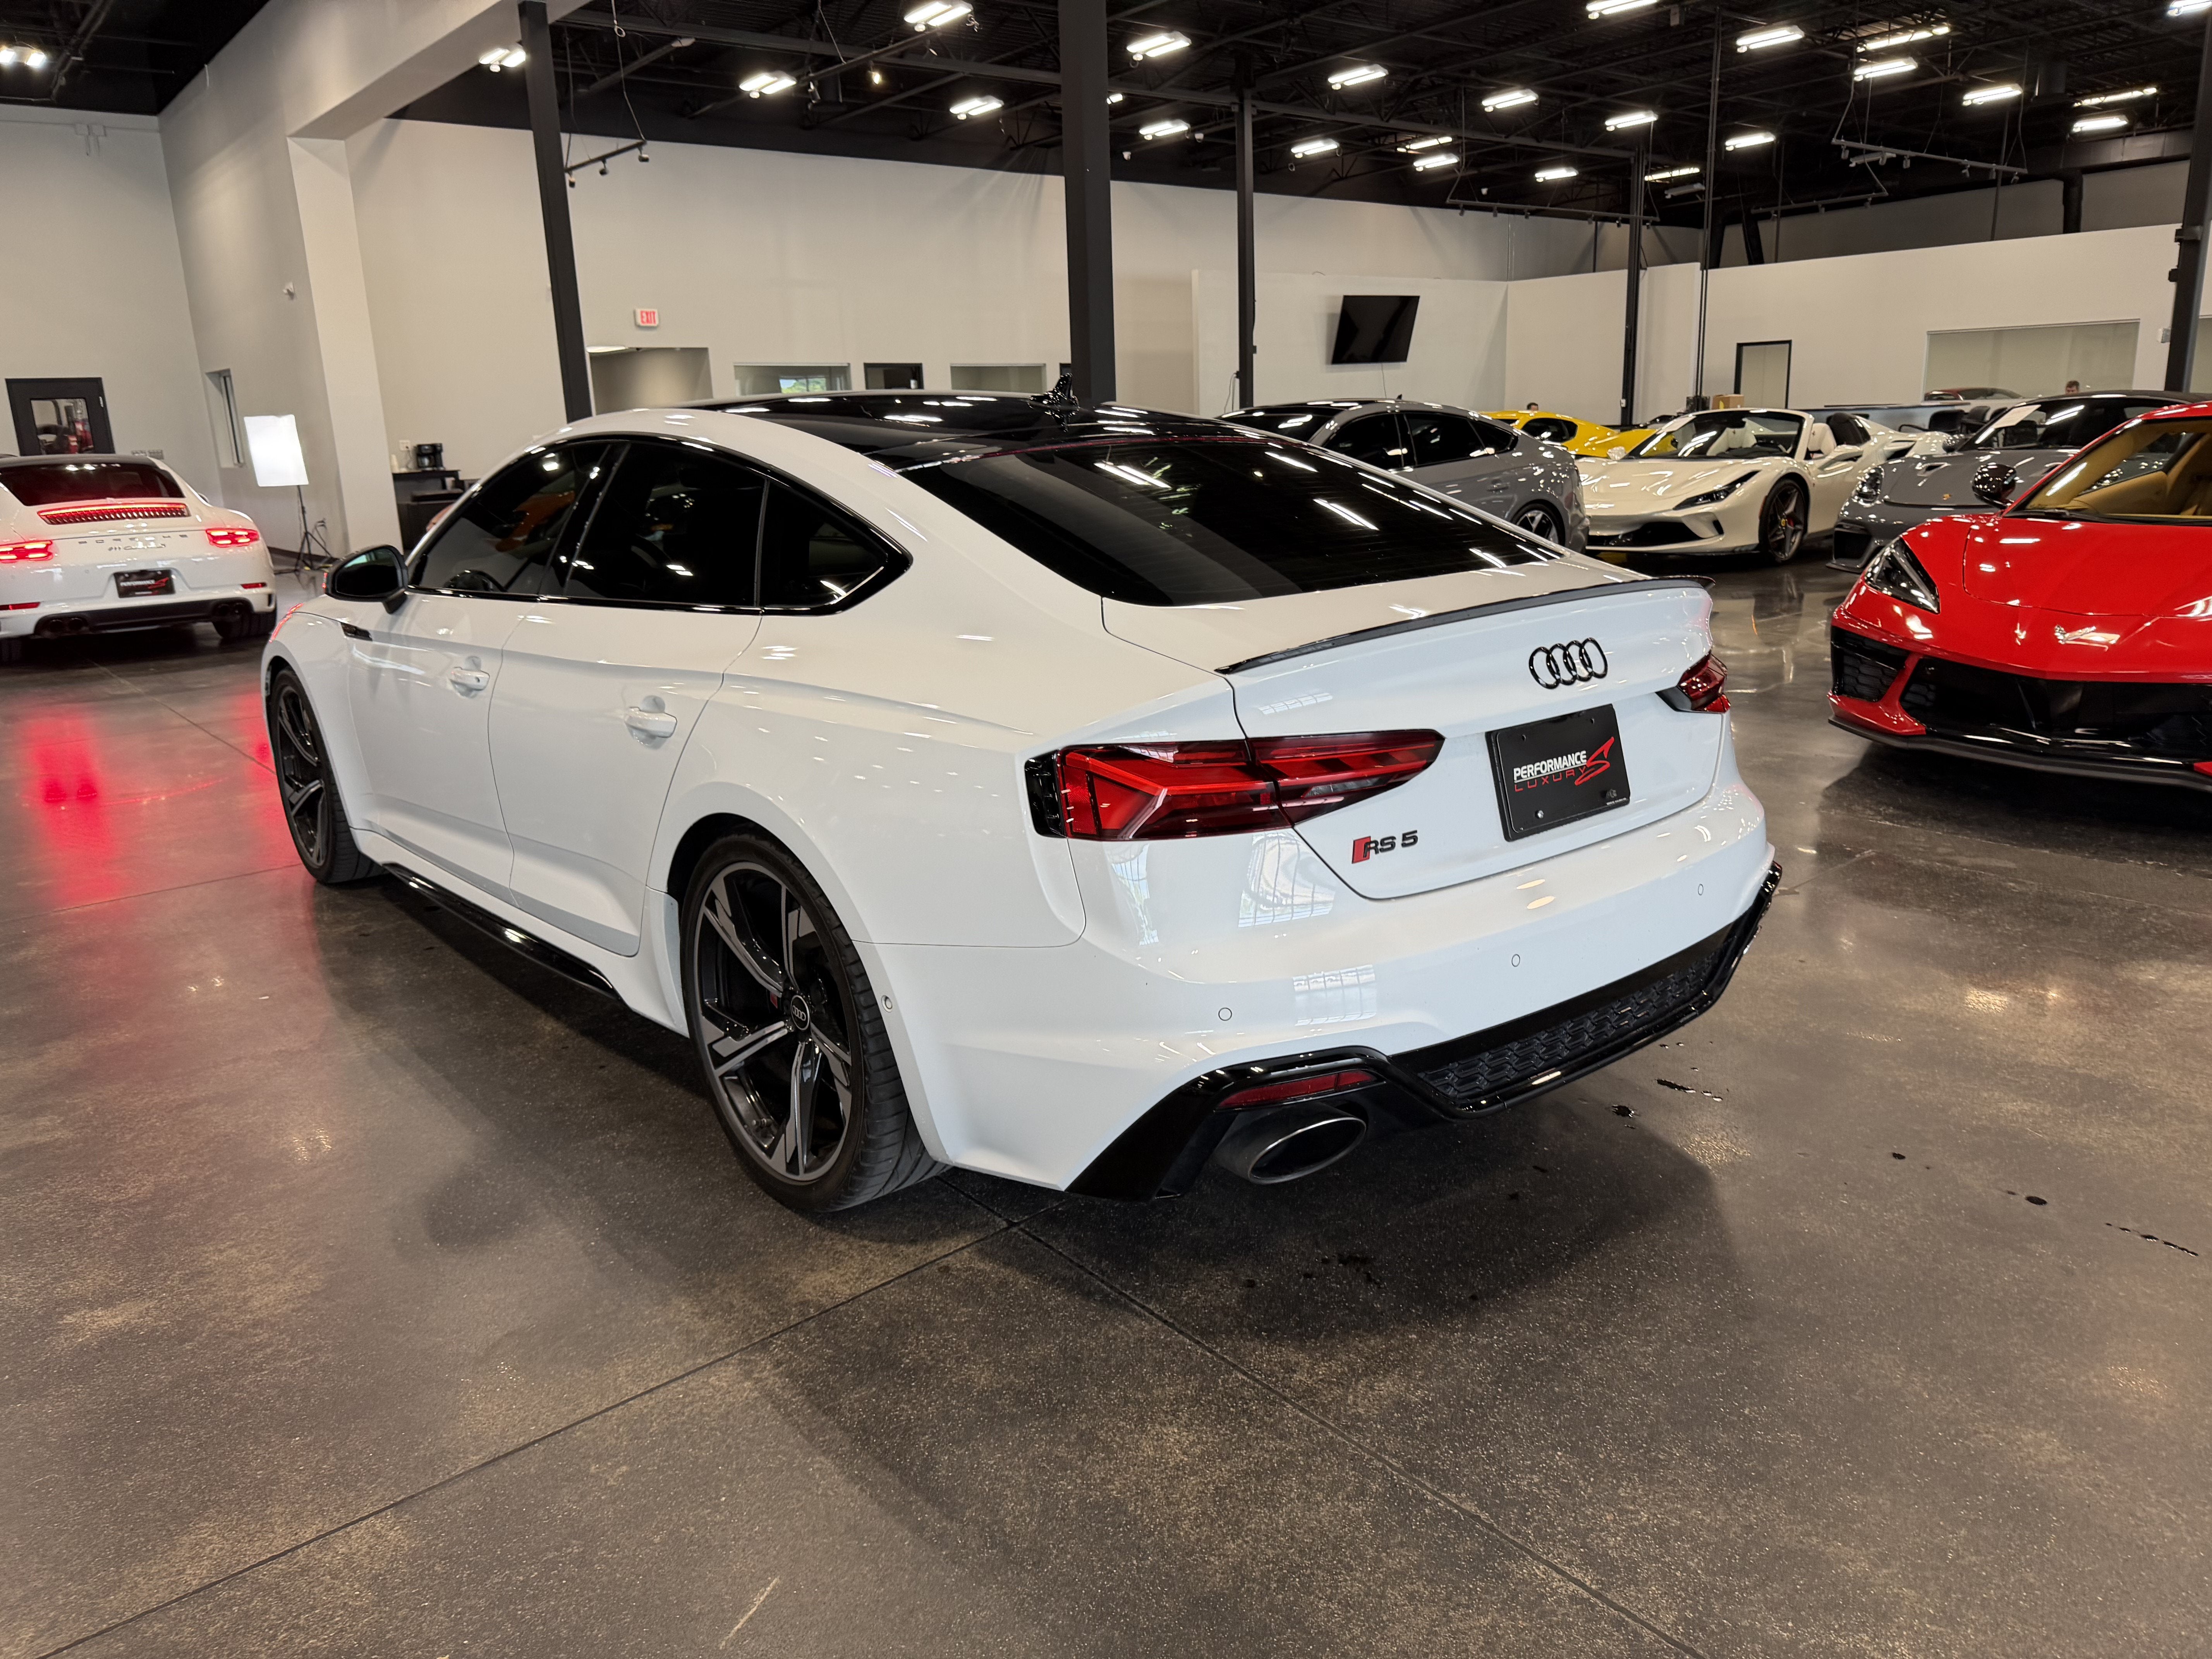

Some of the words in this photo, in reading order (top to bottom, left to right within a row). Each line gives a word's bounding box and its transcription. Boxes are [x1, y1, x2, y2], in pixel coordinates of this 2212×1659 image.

[640, 310, 656, 324] EXIT
[78, 534, 189, 544] PORSHE
[1513, 750, 1587, 781] PERFORMANCE
[1515, 766, 1586, 792] LUXURY
